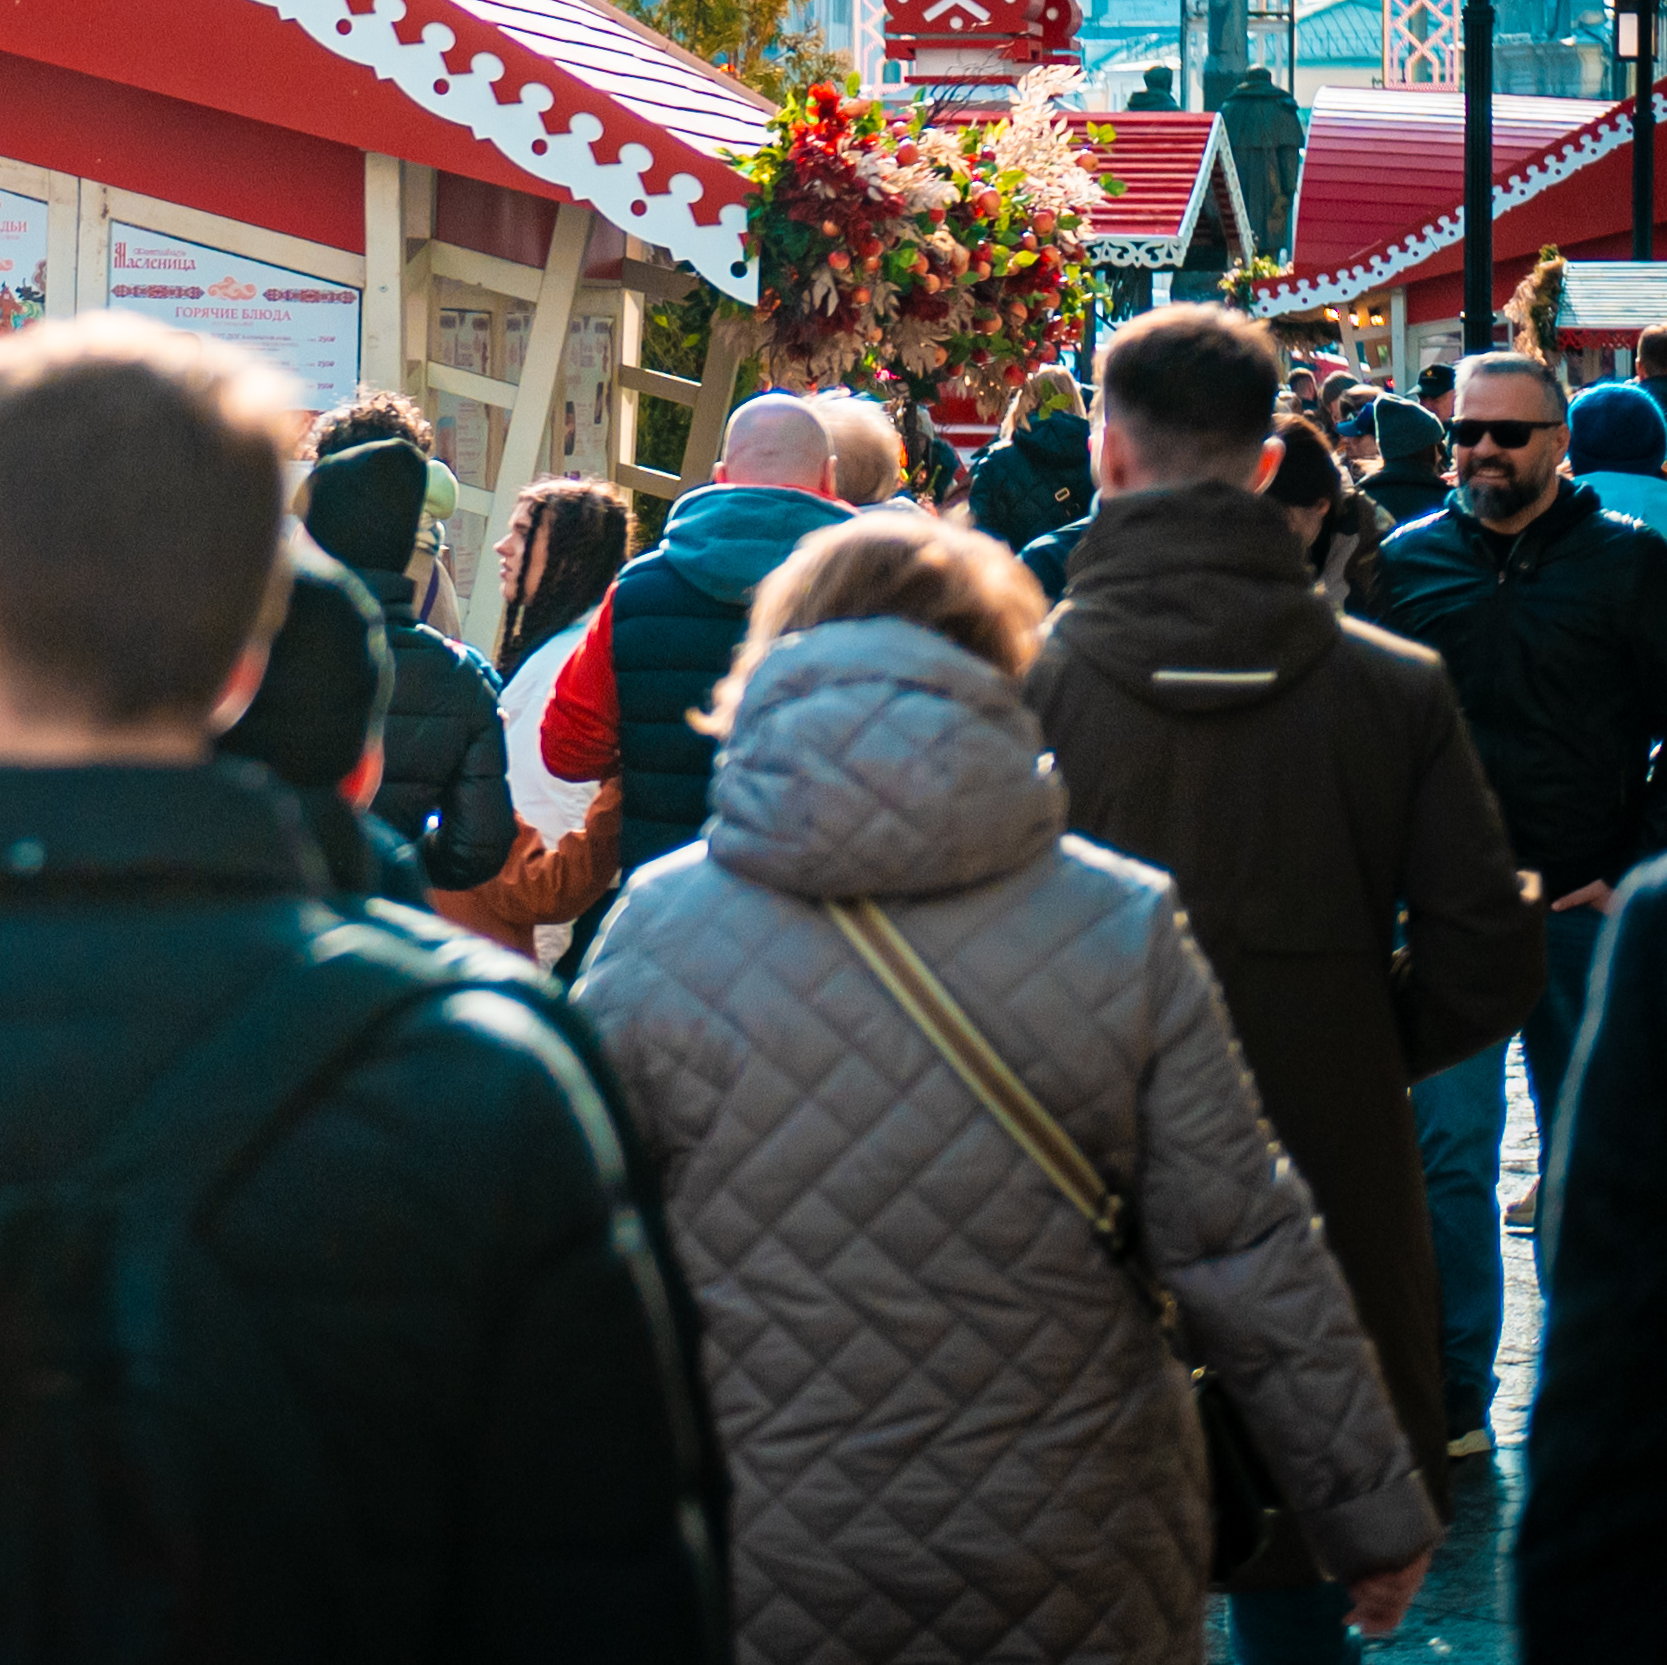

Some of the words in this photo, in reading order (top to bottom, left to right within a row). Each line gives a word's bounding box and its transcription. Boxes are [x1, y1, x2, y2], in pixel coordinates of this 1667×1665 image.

[114, 241, 196, 271] Масленица
[175, 306, 238, 319] ГОРЯЧИЕ
[242, 308, 291, 321] БЛЮДА
